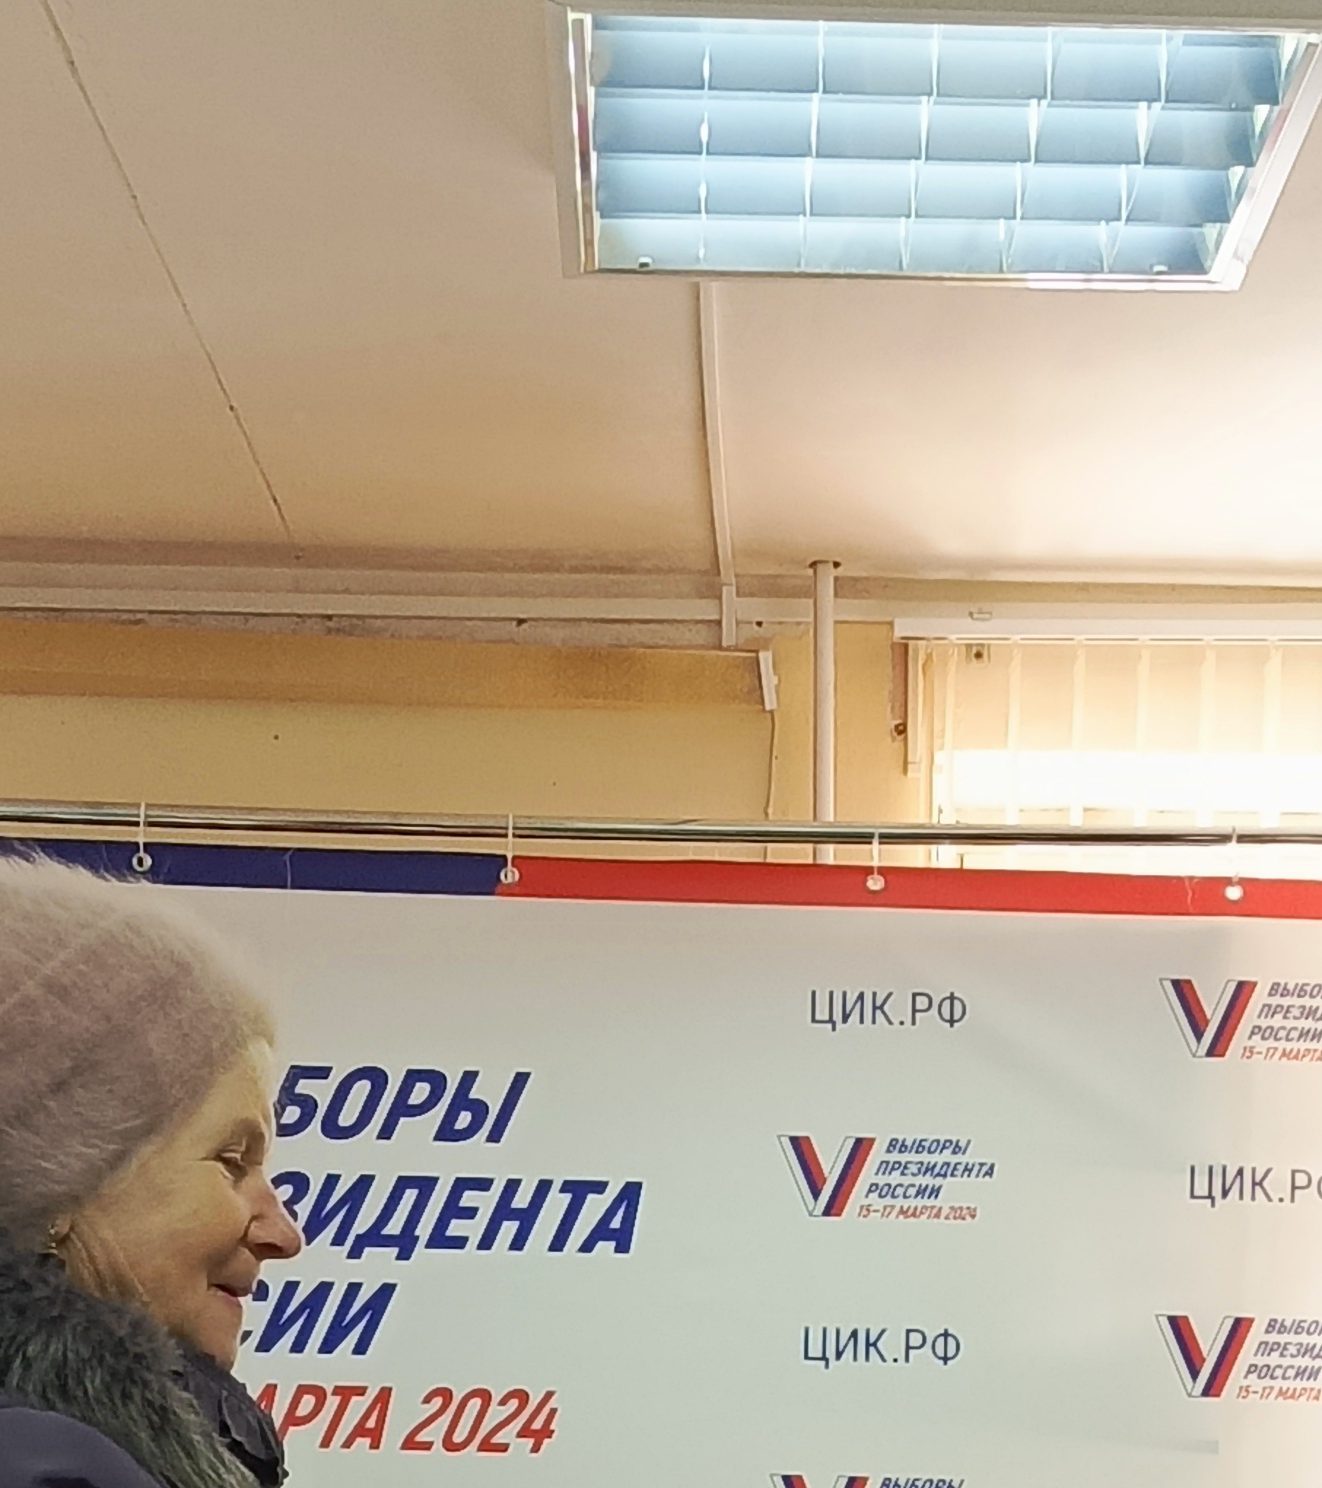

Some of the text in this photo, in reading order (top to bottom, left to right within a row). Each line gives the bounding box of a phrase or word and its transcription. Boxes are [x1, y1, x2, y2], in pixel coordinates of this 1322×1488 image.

[811, 990, 966, 1032] ЦИК.РФ
[273, 1065, 531, 1144] БОРЫ
[885, 1138, 971, 1155] ВЫБОРЫ
[874, 1160, 995, 1180] ПРЕЗИДЕНТА
[865, 1183, 943, 1200] РОССИИ
[271, 1171, 643, 1262] ЗИДЕНТА
[896, 1205, 943, 1220] МАРТА
[944, 1206, 977, 1221] 2024
[804, 1326, 960, 1370] ЦИК.РФ
[1243, 1363, 1321, 1381] РОССИИ
[1275, 1386, 1321, 1401] МАРТА
[256, 1383, 559, 1455] АРТА 2024
